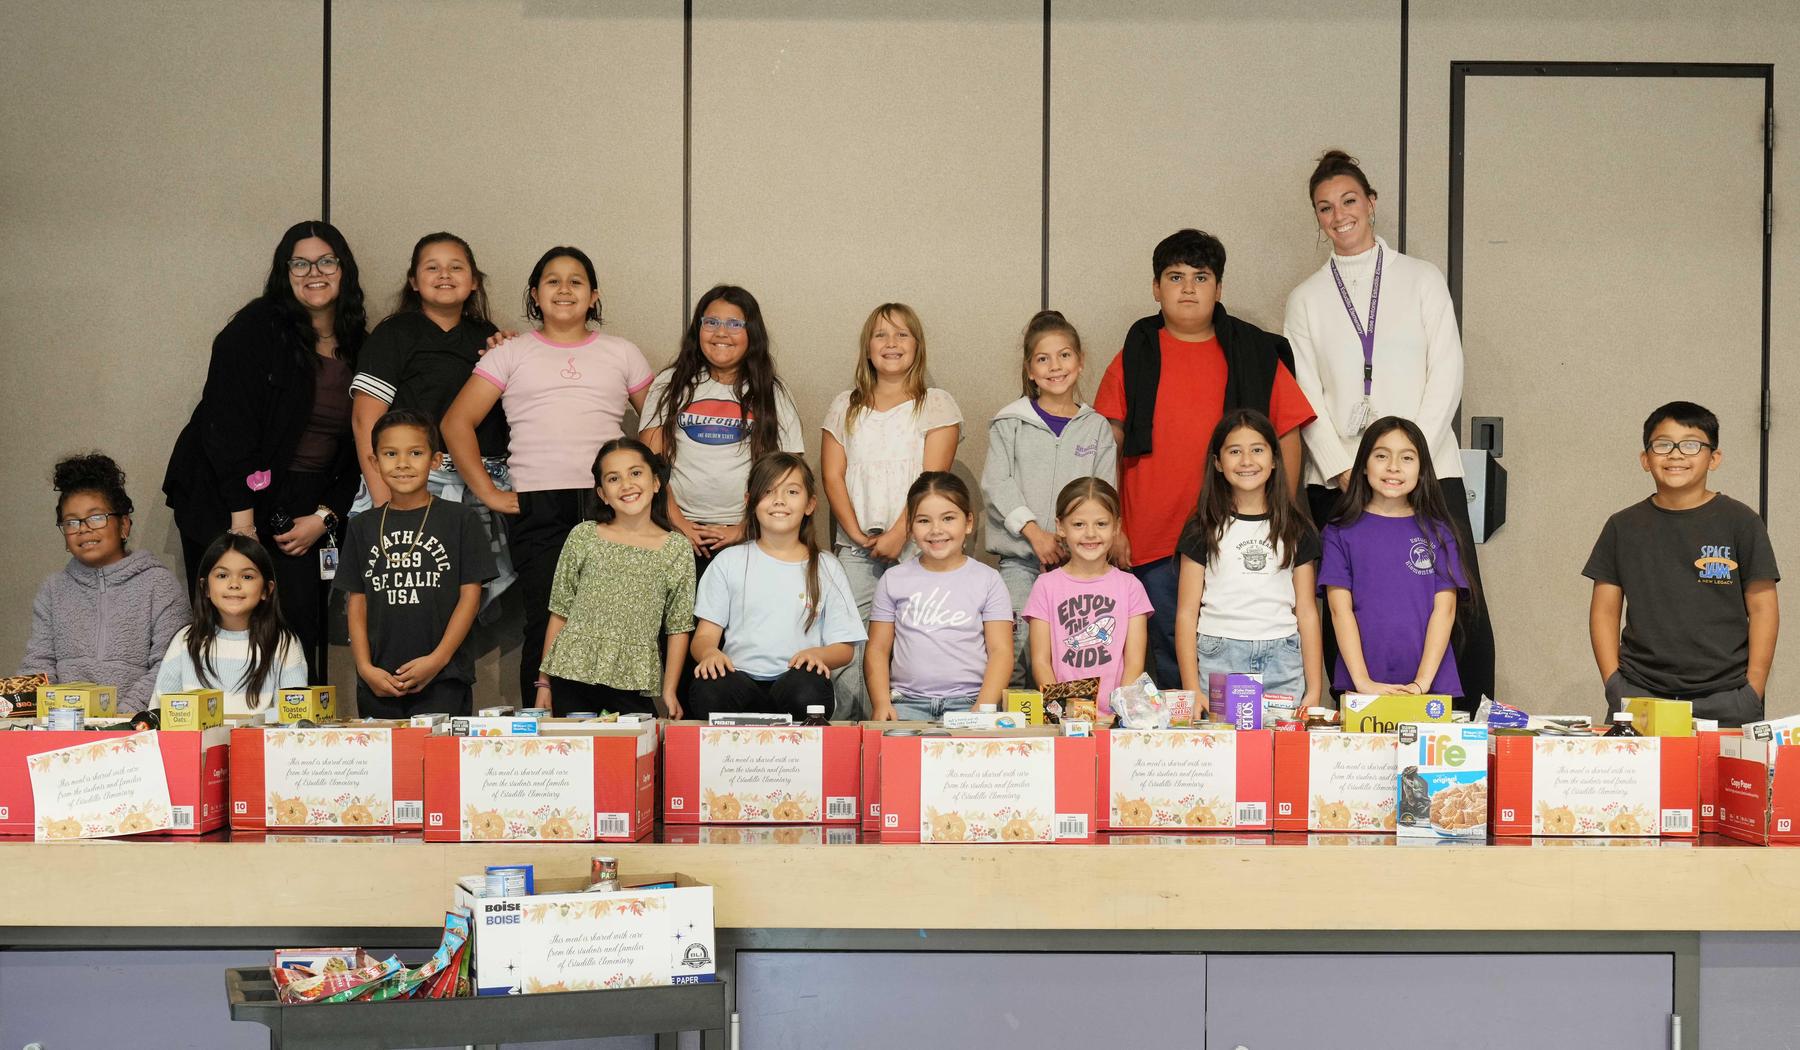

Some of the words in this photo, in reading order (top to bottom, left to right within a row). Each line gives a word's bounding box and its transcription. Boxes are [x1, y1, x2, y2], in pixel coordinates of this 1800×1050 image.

[383, 531, 451, 571] ATHLETIC
[1236, 540, 1257, 550] SMOKEY
[1701, 545, 1730, 560] SPACE
[386, 551, 421, 569] 1969
[1699, 562, 1730, 579] JAM
[394, 572, 440, 587] CALIF.
[387, 589, 419, 604] USA
[901, 587, 972, 626] Nike
[1057, 594, 1116, 625] ENJOY
[1065, 617, 1089, 635] THE
[1062, 645, 1112, 668] RIDE
[1419, 735, 1466, 766] life
[1432, 775, 1457, 784] original
[1731, 778, 1740, 788] Copy
[1740, 780, 1752, 790] Paper
[1503, 810, 1513, 818] 10
[486, 915, 520, 925] BOISE
[551, 934, 563, 944] This
[565, 933, 583, 943] meal
[591, 931, 613, 941] shared
[614, 930, 627, 939] with
[547, 947, 563, 961] from
[566, 946, 575, 955] the
[578, 945, 602, 954] students
[604, 943, 619, 952] and
[617, 942, 644, 957] families
[557, 959, 566, 973] of
[599, 957, 634, 966] Elementary
[677, 976, 698, 984] PAPER
